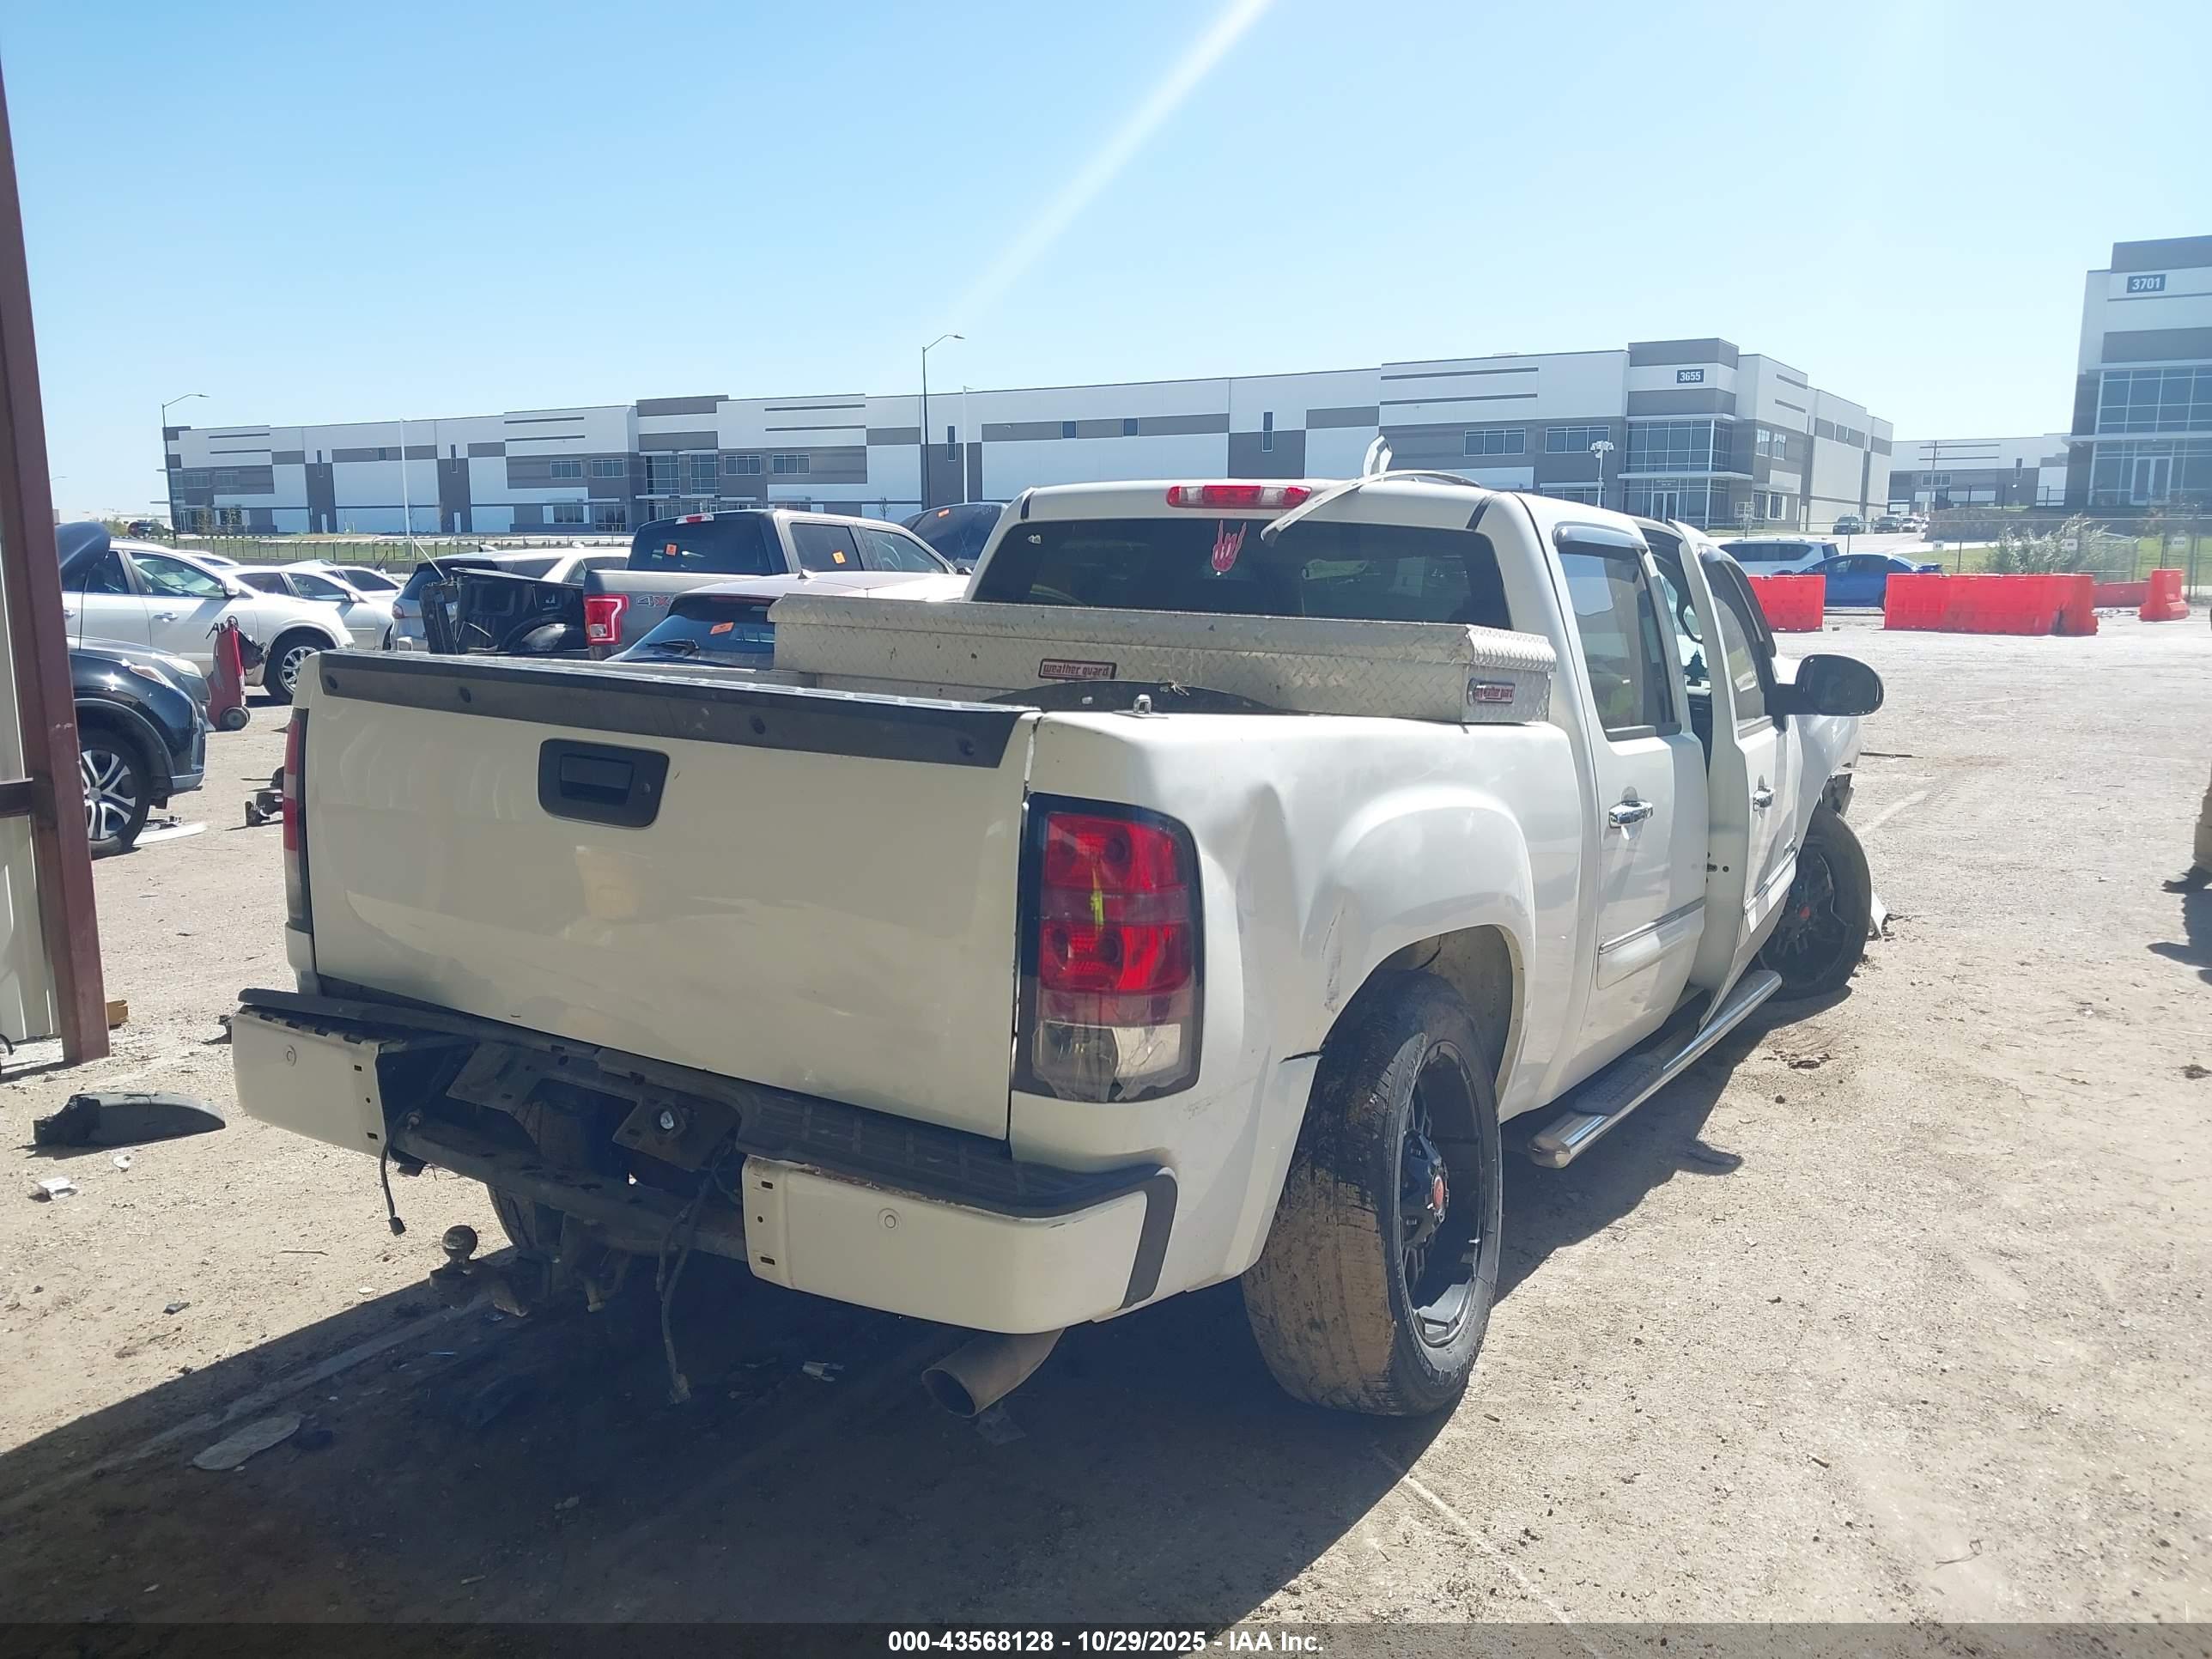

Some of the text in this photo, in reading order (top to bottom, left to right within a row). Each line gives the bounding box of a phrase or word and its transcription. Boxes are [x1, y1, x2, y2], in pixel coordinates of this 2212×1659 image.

[2132, 277, 2160, 289] 3701
[1680, 371, 1701, 381] 3655
[636, 594, 676, 606] 4X
[1042, 663, 1080, 675] weather
